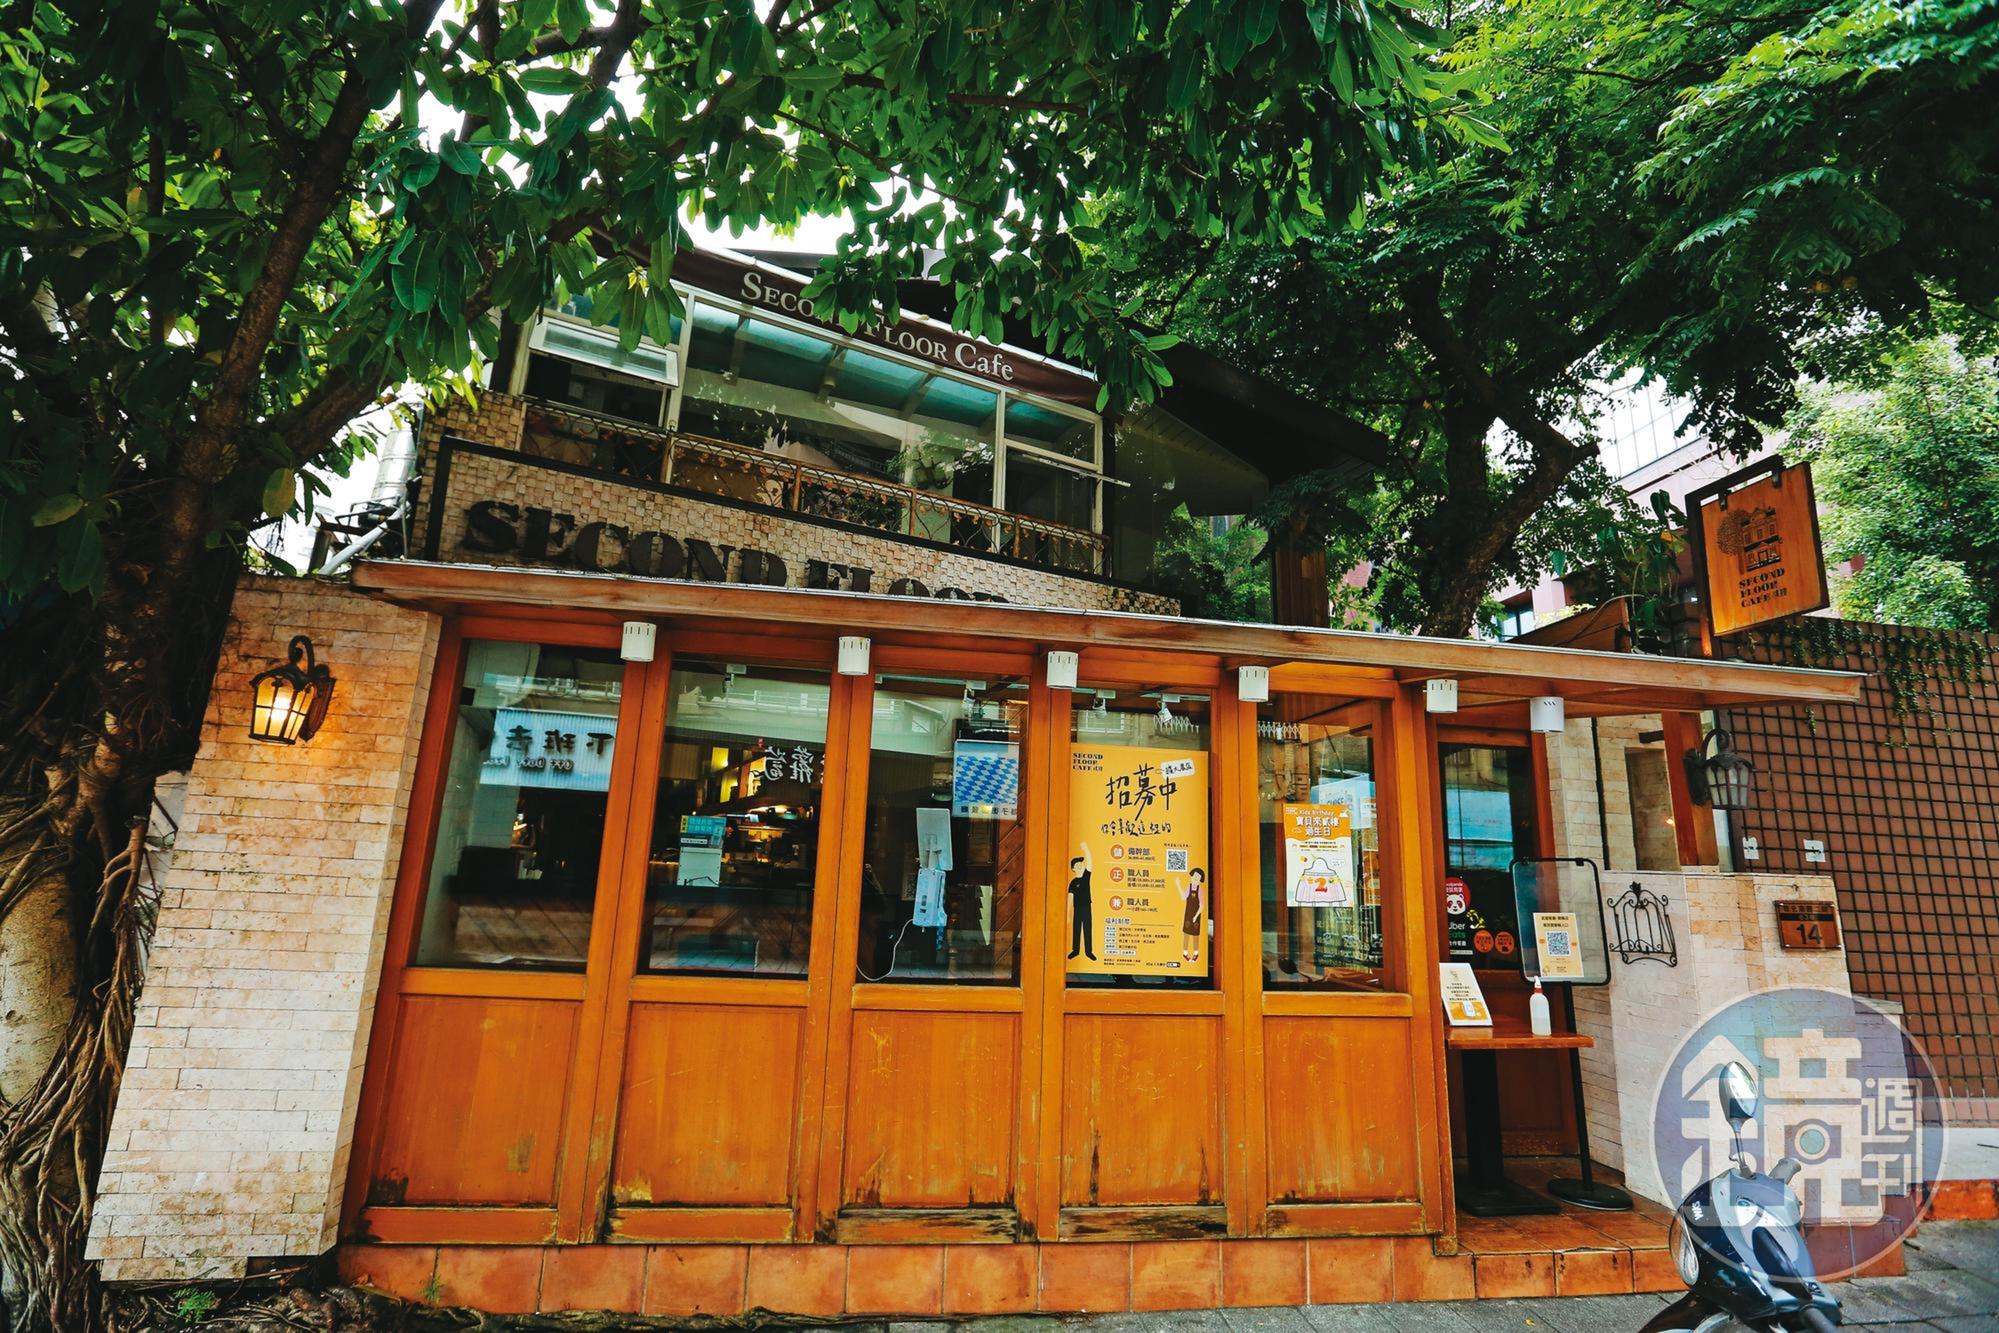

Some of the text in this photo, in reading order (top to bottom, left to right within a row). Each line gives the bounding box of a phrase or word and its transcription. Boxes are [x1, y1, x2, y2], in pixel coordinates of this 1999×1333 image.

[741, 271, 843, 325] SECO
[954, 342, 1014, 381] Cafe
[464, 500, 788, 587] SECOND
[1739, 567, 1785, 589] SECOND
[1741, 594, 1771, 608] CAFE
[1105, 763, 1178, 821] 招募中
[1796, 923, 1823, 945] 14
[1691, 1200, 1704, 1221] SYM
